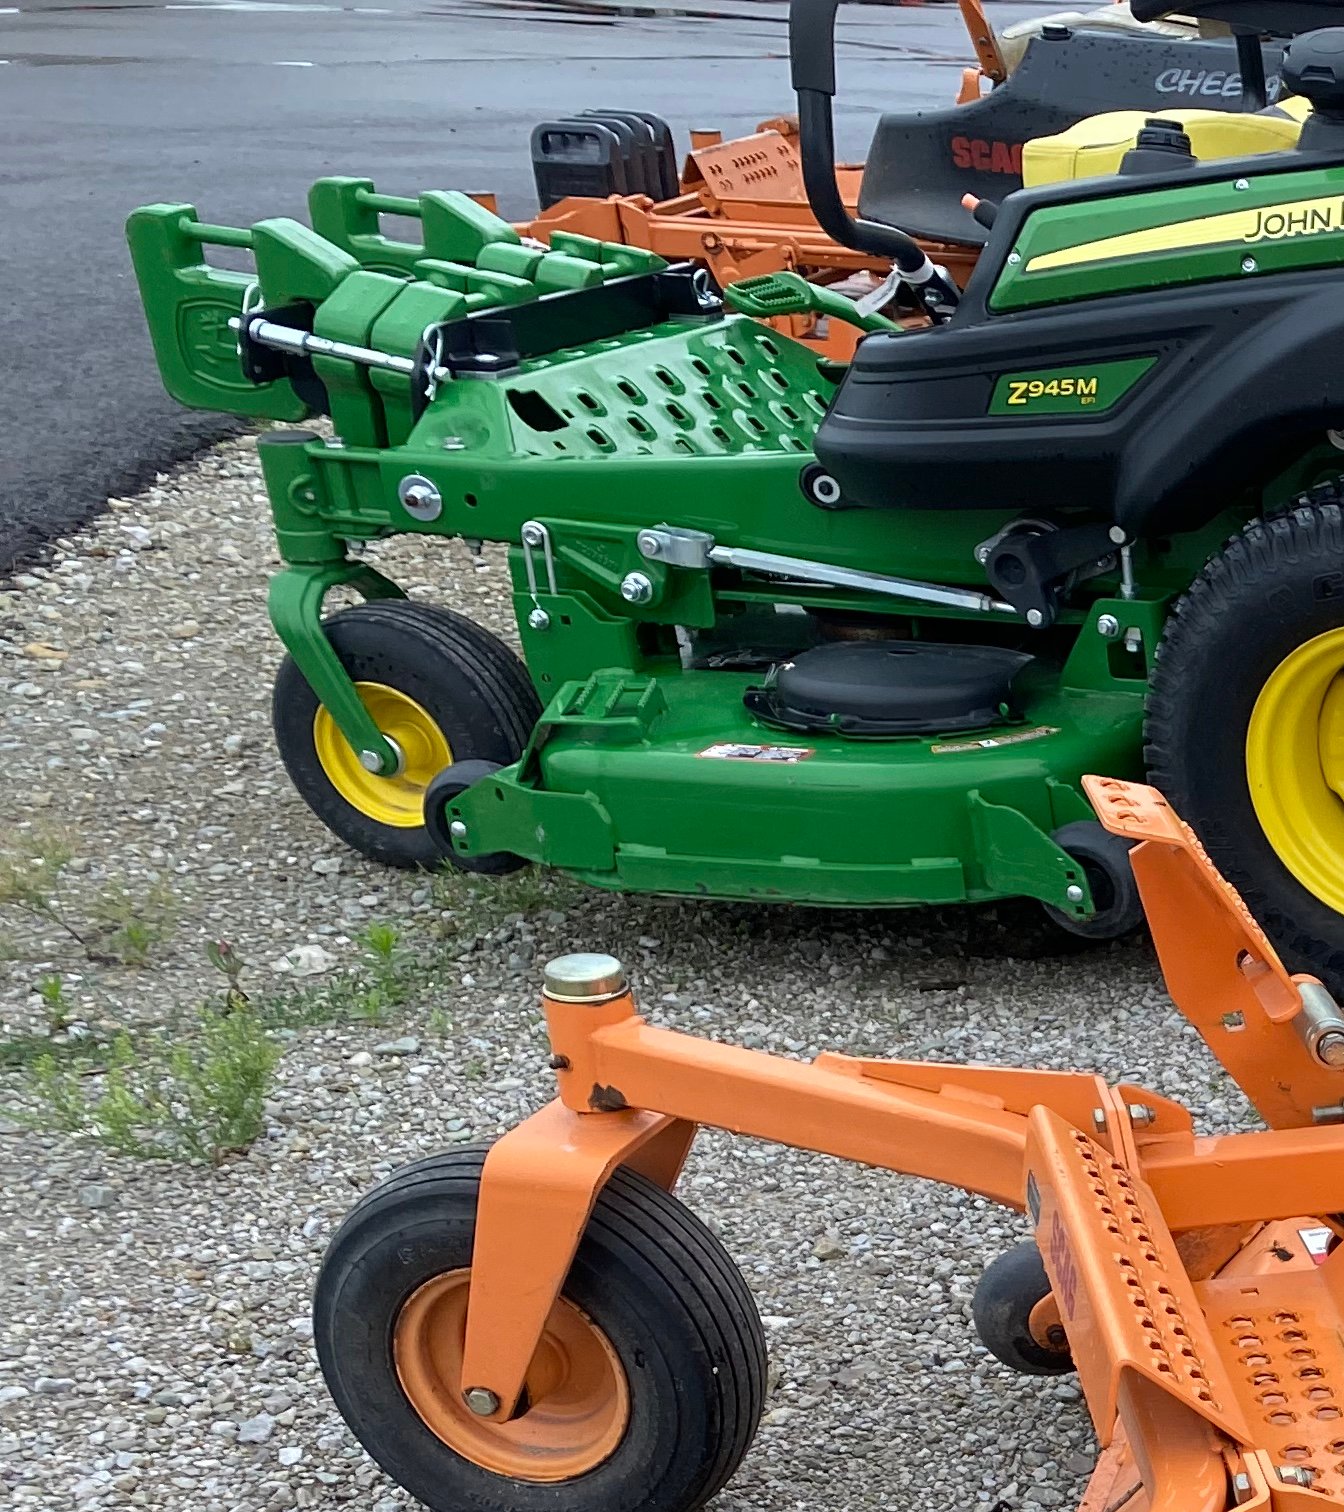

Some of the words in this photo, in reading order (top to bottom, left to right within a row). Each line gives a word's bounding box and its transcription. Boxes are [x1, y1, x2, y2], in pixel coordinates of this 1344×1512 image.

[1155, 68, 1280, 100] CHEEA
[1245, 207, 1331, 238] JOHN
[1008, 378, 1097, 404] Z945M
